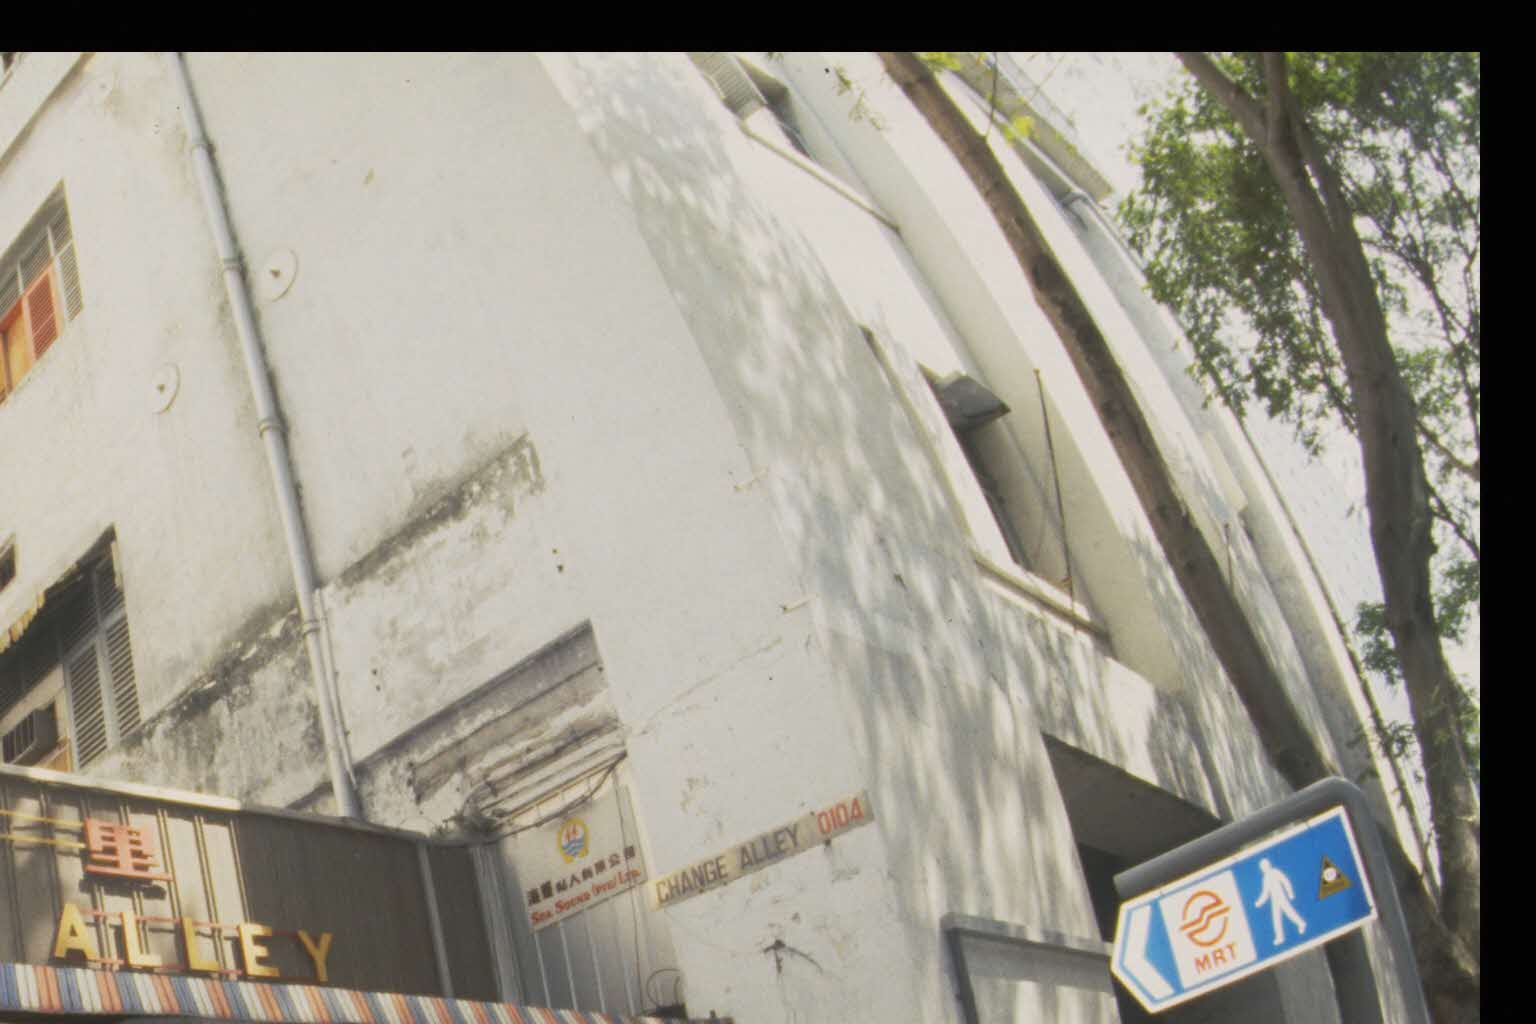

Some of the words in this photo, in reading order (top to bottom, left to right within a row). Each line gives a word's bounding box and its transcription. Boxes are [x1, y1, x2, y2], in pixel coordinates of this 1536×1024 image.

[655, 853, 728, 906] CHANGE
[739, 826, 801, 872] ALLEY
[54, 903, 333, 982] ALLEY
[1194, 942, 1239, 974] MRT
